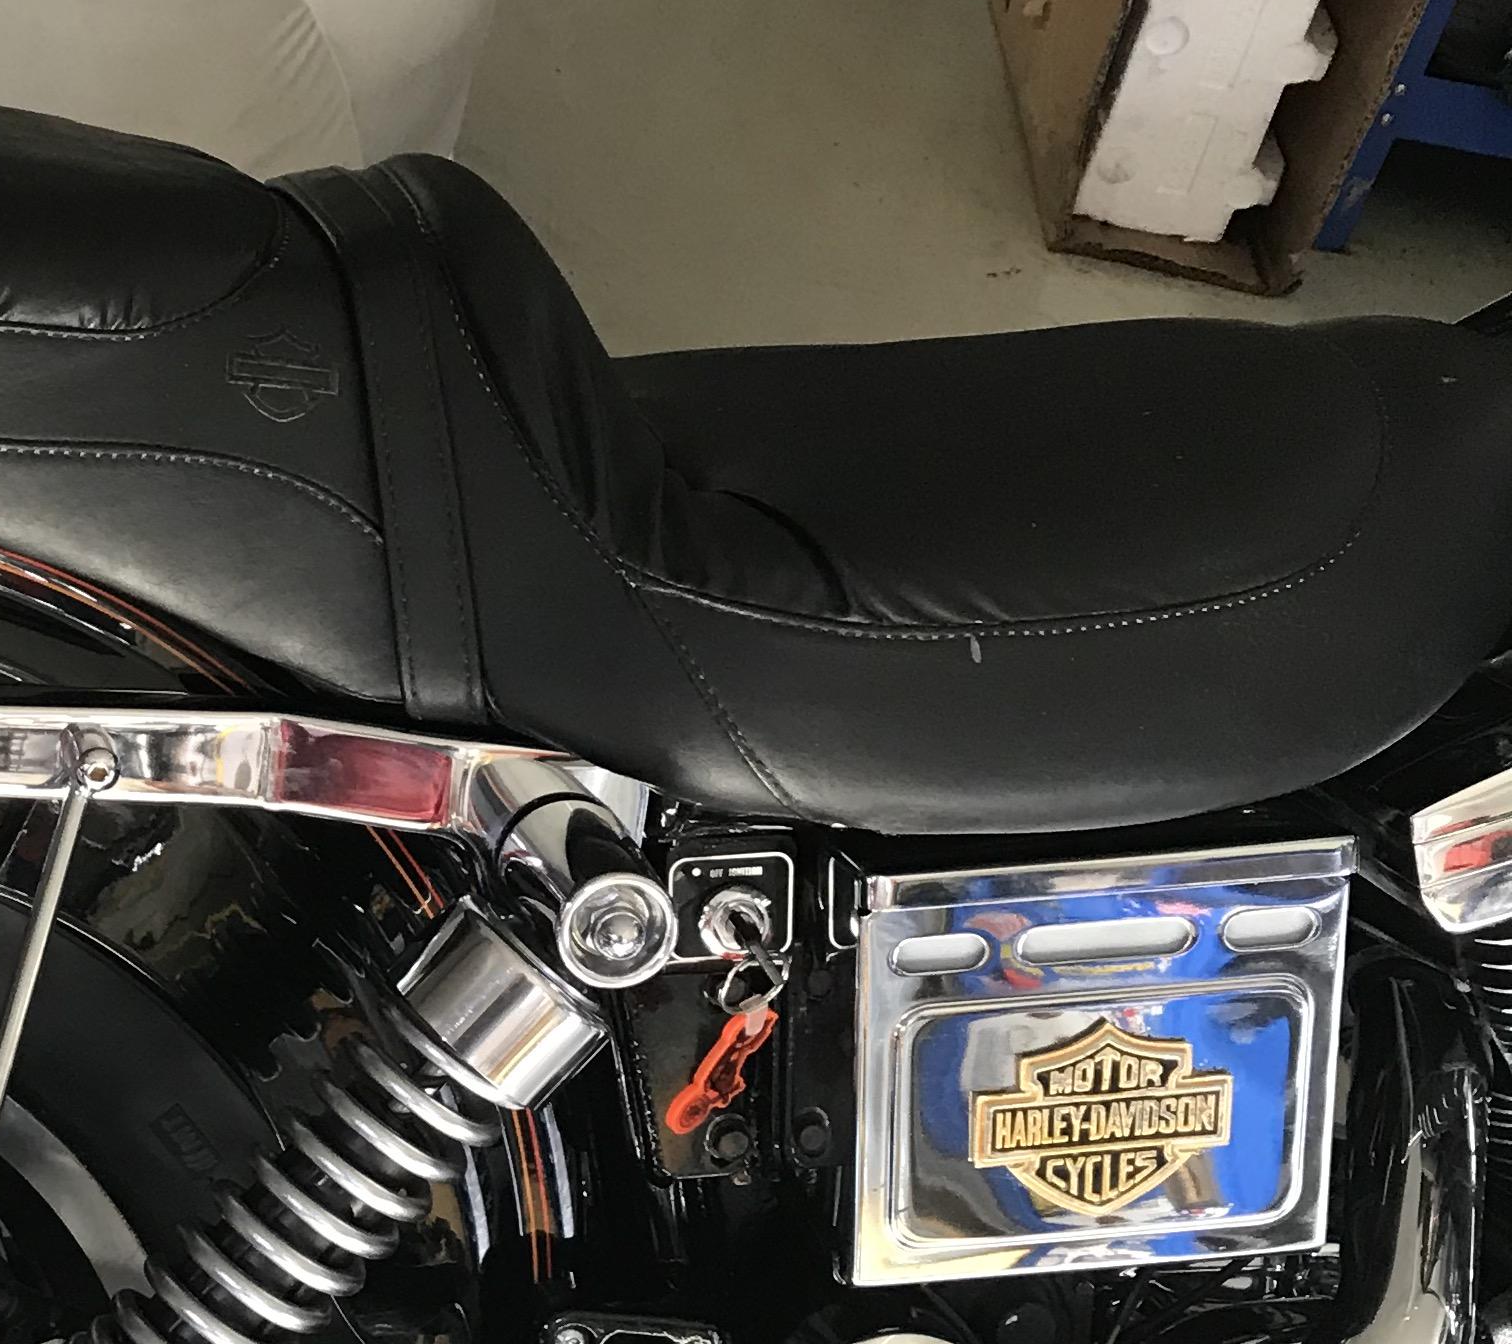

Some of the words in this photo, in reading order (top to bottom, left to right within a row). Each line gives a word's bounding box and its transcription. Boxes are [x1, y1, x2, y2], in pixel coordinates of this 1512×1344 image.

[1049, 1047, 1164, 1096] MOTOR
[995, 1093, 1217, 1150] HARLEY-DAVIDSON
[1045, 1150, 1158, 1203] CYCLES
